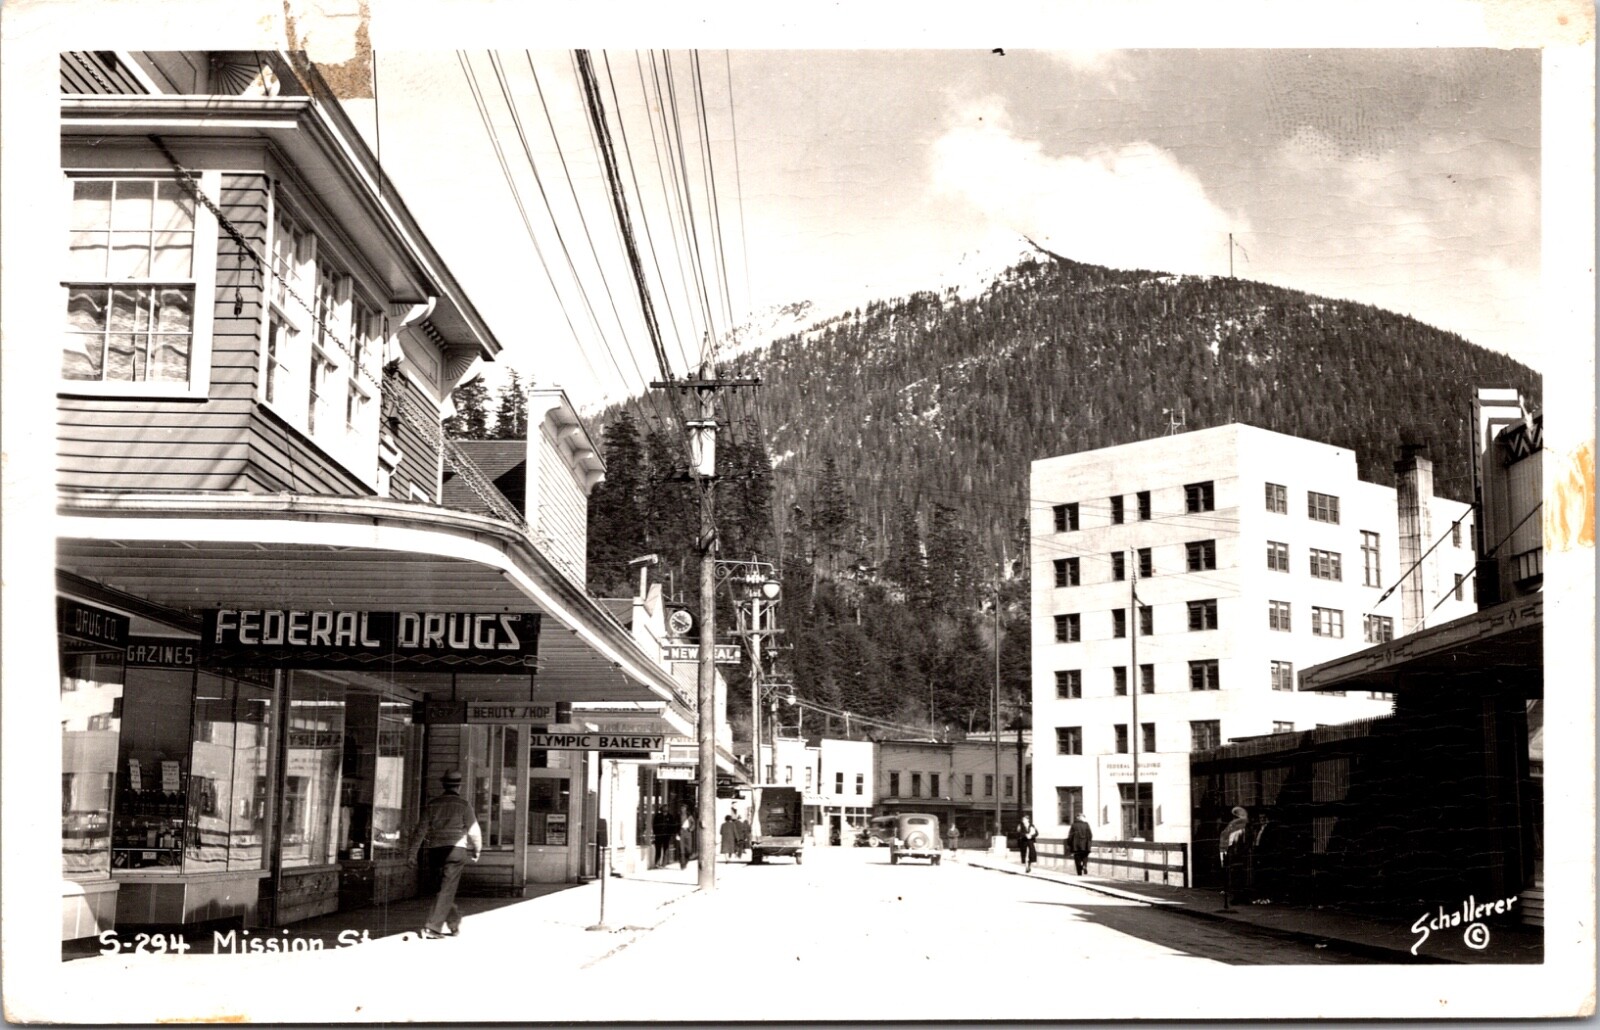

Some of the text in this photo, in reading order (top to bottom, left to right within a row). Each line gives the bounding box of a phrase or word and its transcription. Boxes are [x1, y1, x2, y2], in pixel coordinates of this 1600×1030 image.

[75, 608, 118, 642] DRUG CO.
[215, 609, 521, 650] FEDERAL DRUGS
[126, 644, 194, 665] GAZINES
[671, 647, 734, 659] NEW EAL
[473, 706, 516, 719] BEAUTY
[530, 735, 591, 747] OLYMPIC
[598, 736, 662, 749] BAKERY
